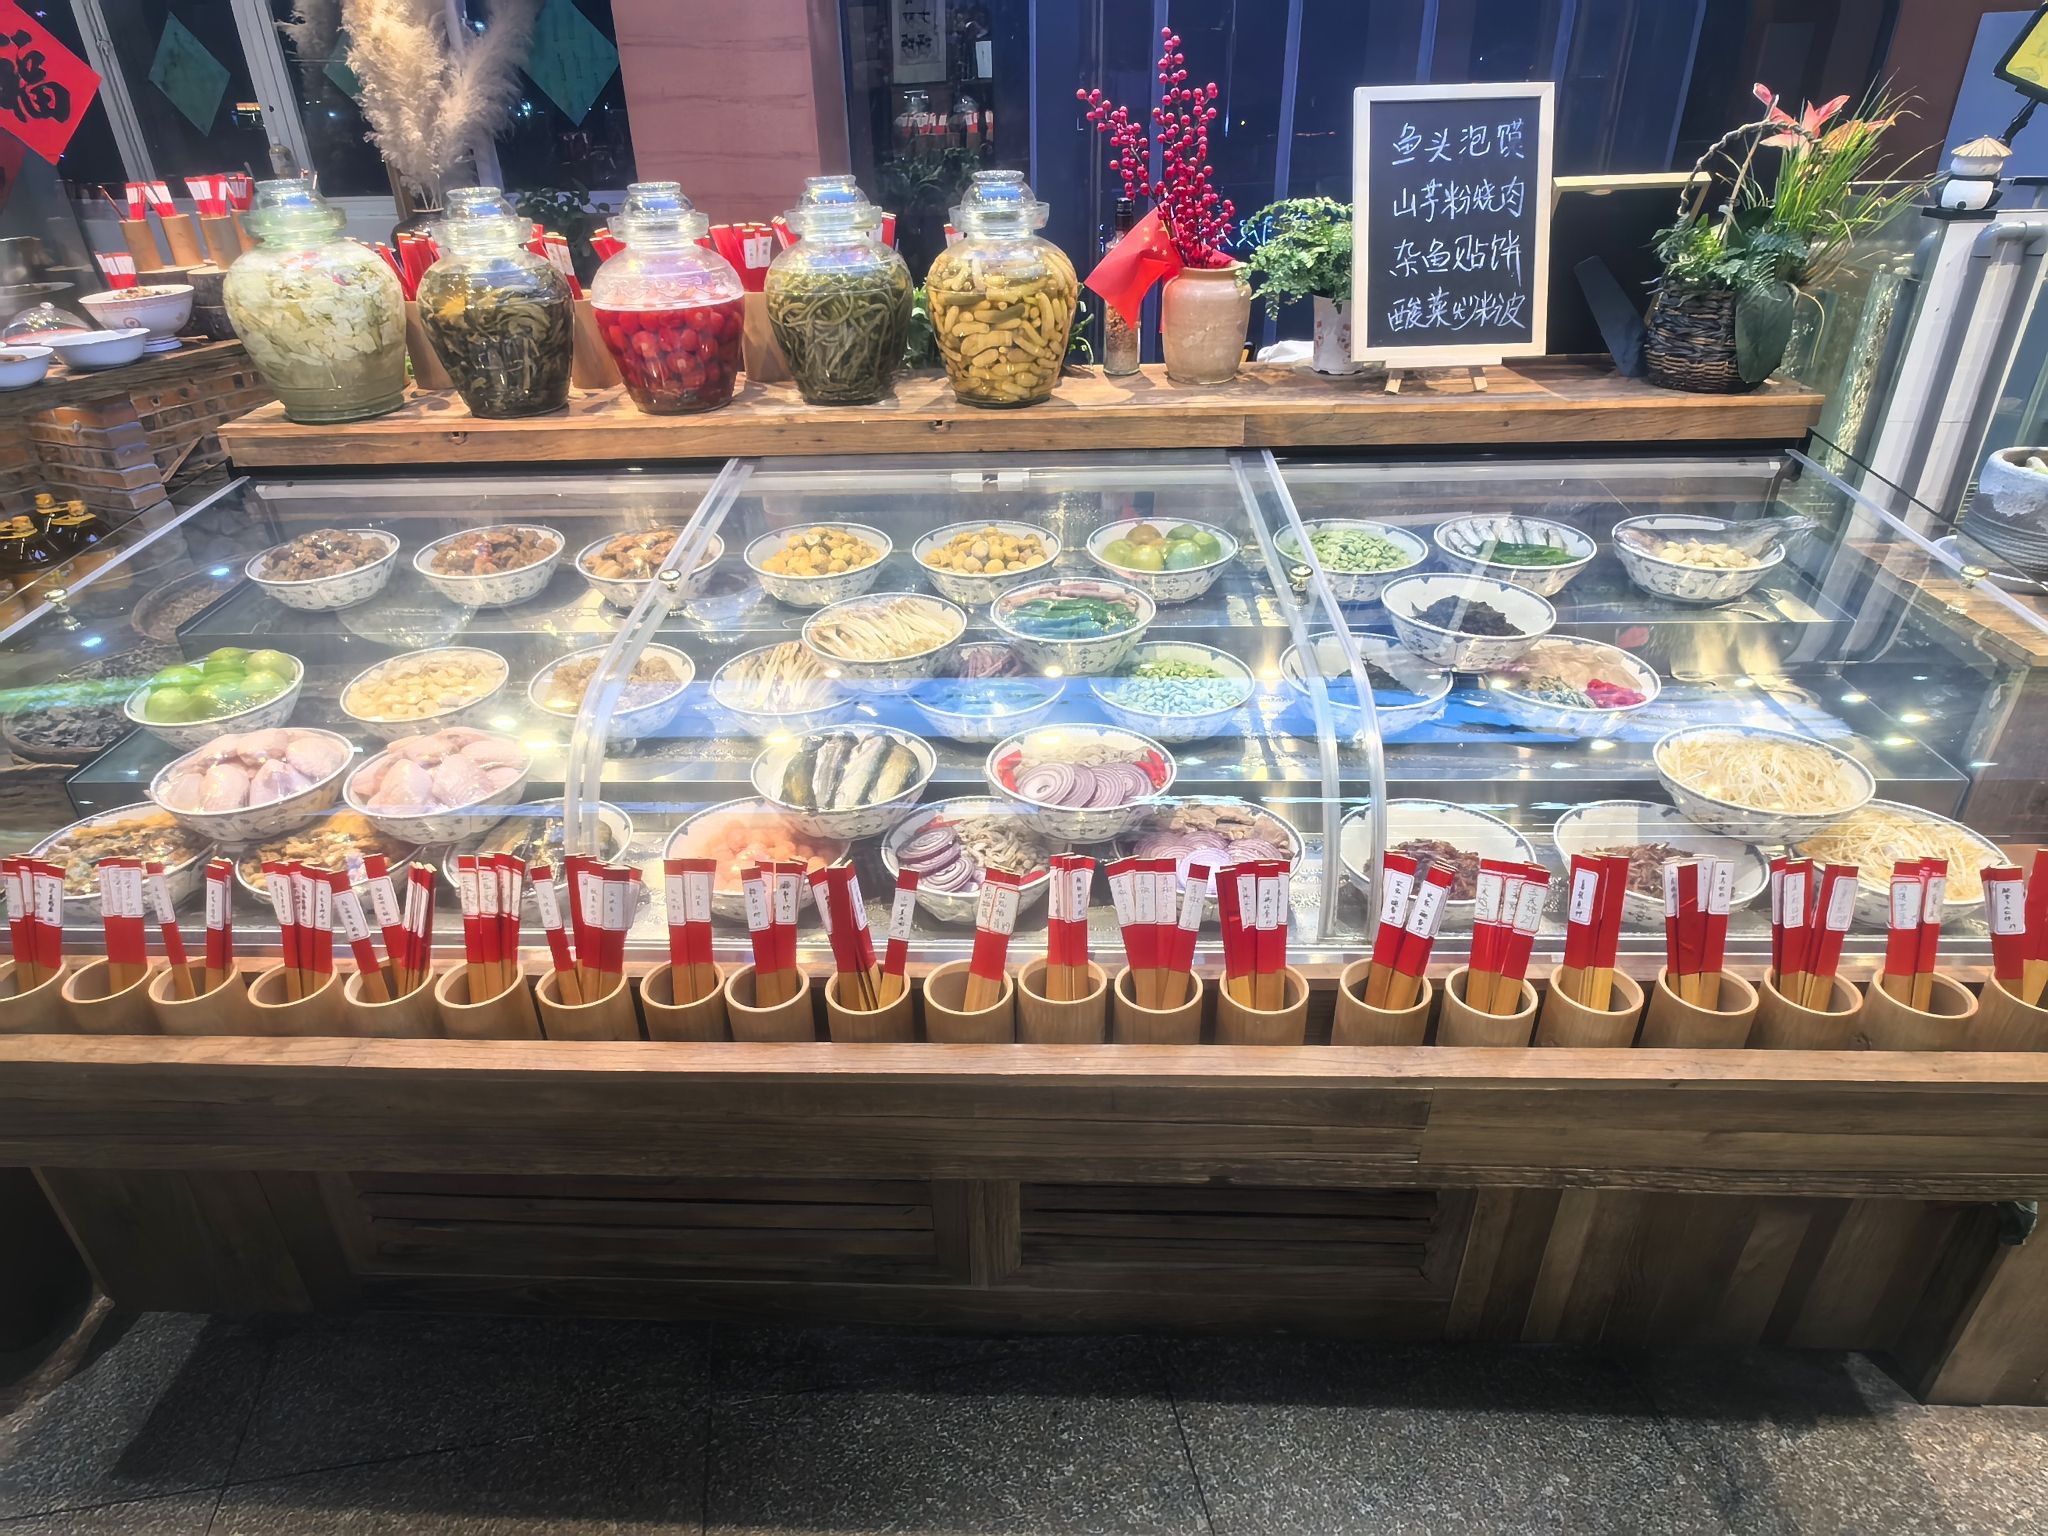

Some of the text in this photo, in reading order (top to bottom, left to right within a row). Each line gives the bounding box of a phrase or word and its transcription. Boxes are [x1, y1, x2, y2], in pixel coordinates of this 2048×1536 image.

[0, 29, 71, 123] 福
[1392, 118, 1525, 165] 鱼头泡馍
[1393, 176, 1525, 223] 山芋粉烧肉
[1389, 230, 1522, 286] 杂鱼贴饼
